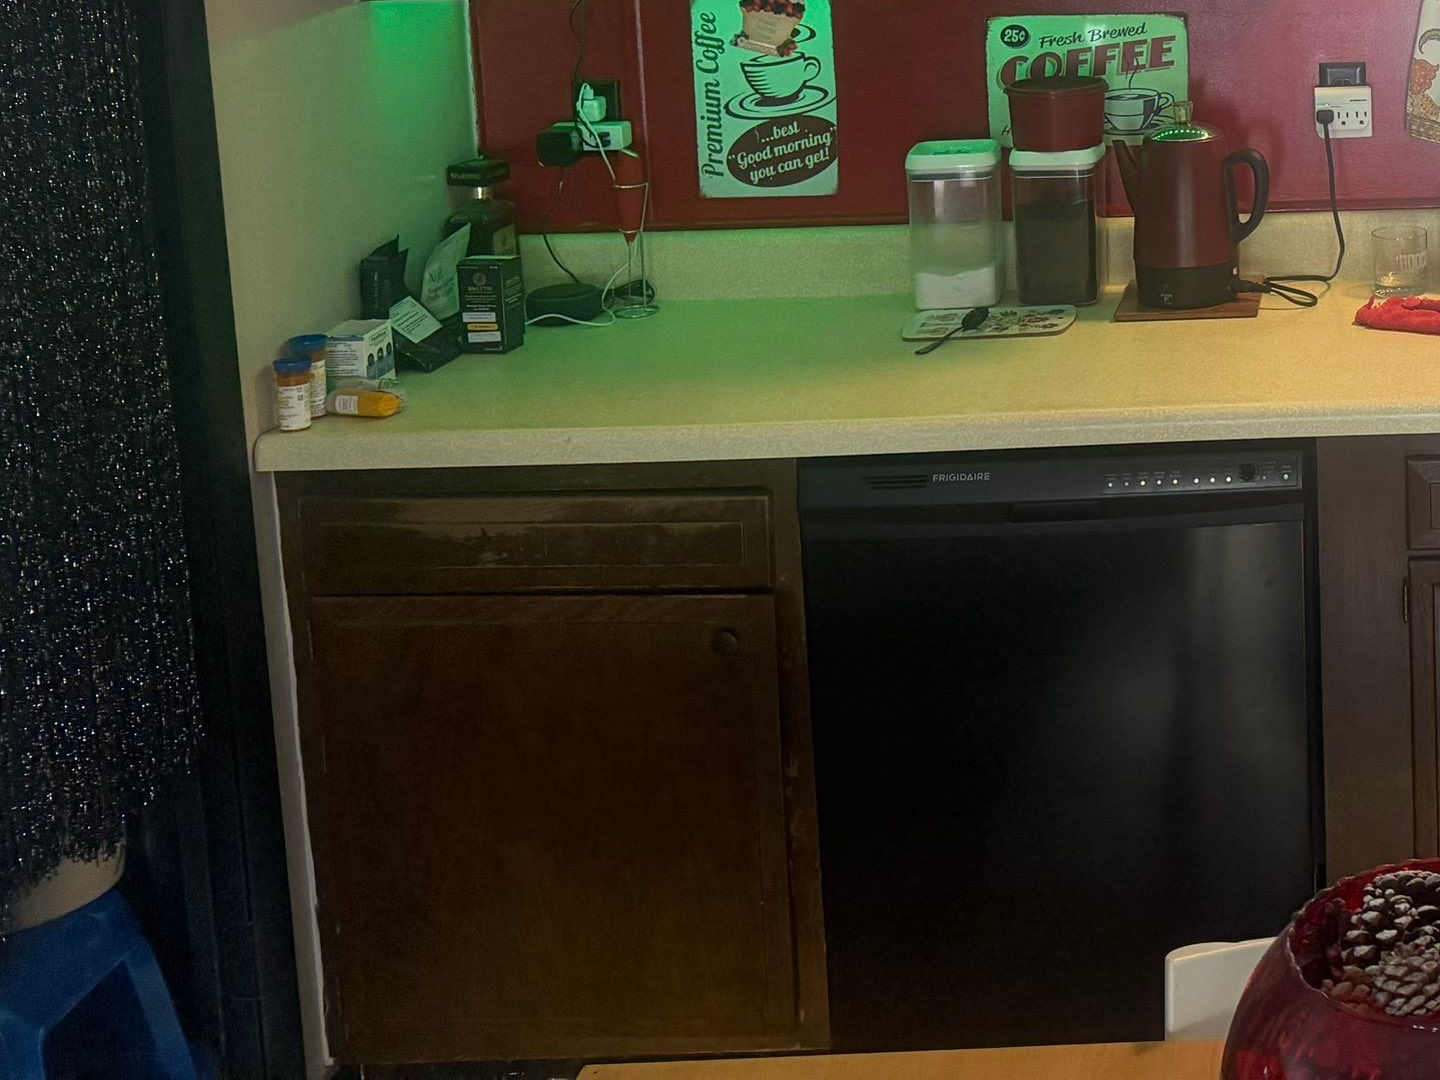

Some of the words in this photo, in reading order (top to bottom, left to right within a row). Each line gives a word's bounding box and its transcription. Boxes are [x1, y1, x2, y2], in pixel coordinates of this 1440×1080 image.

[694, 11, 726, 74] Coffee
[1038, 31, 1085, 49] Fresh
[1087, 22, 1147, 43] Brewed
[998, 35, 1176, 89] COFFEE
[700, 78, 725, 179] Premium
[750, 166, 777, 184] you
[777, 158, 804, 173] can
[805, 146, 830, 169] get!
[932, 472, 990, 482] FRIGIDAIRE
